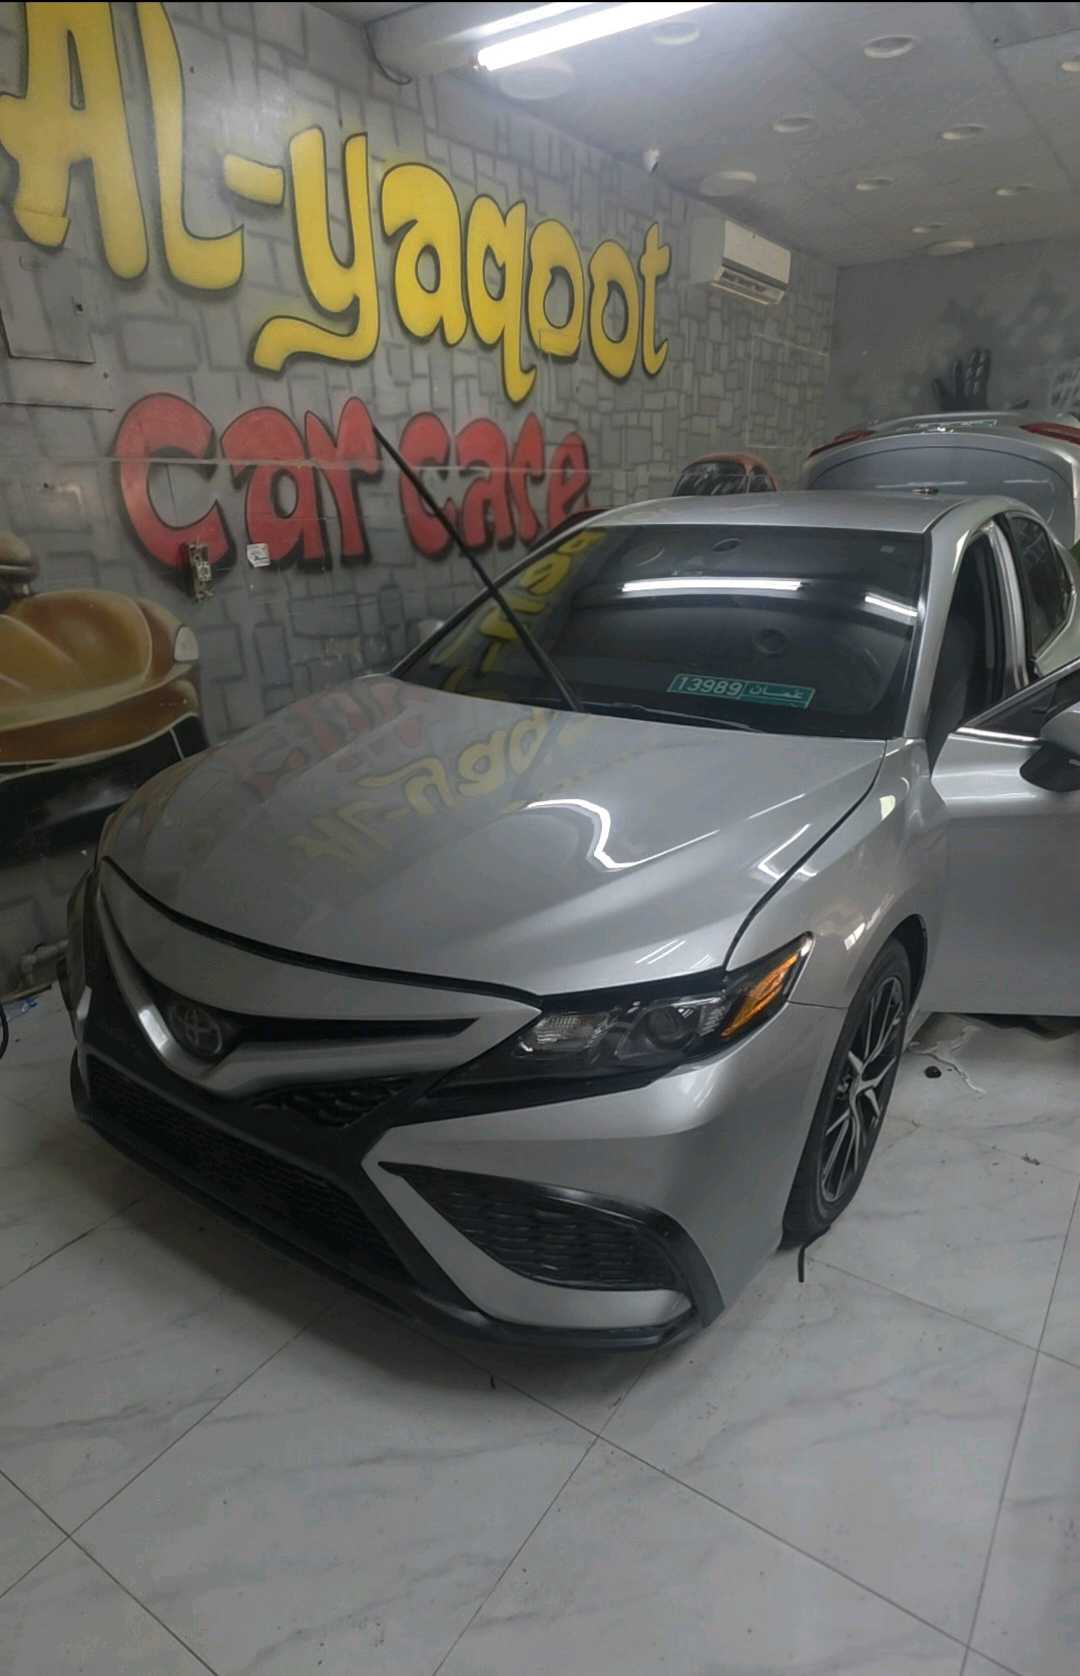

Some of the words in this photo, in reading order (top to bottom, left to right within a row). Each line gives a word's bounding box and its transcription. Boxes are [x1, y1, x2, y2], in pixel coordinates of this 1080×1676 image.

[113, 392, 381, 567] Car
[399, 411, 591, 557] care
[677, 676, 743, 696] 13989
